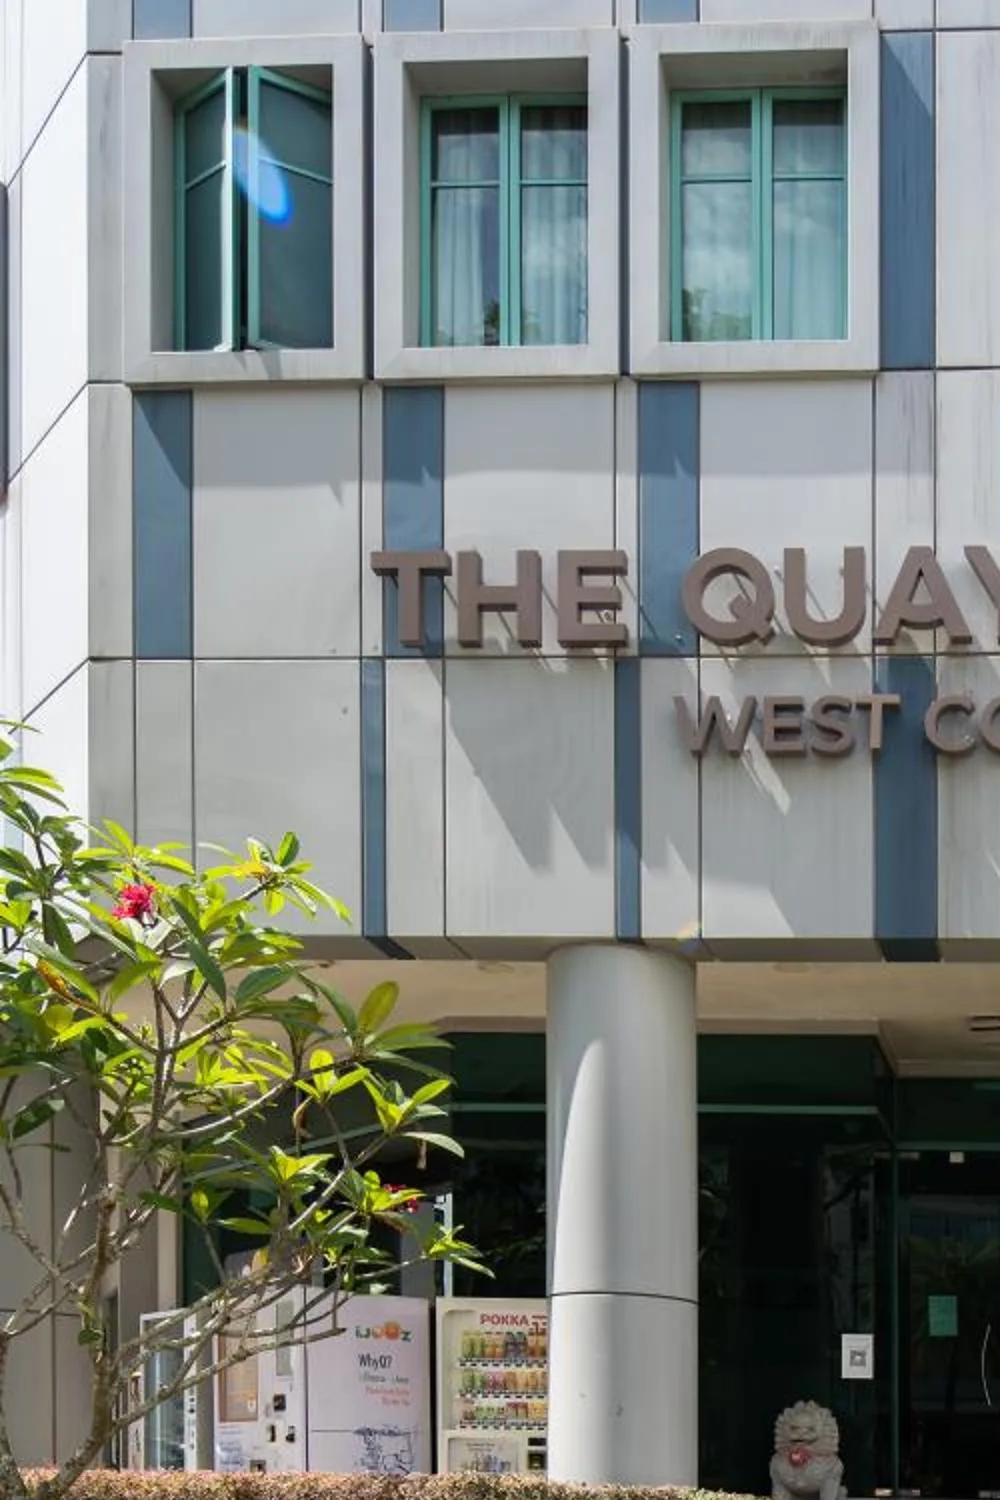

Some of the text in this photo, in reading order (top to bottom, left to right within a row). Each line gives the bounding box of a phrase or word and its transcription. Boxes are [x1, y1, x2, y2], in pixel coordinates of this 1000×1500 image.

[370, 550, 628, 648] THE
[673, 694, 901, 757] WEST
[480, 1313, 529, 1326] POKKA
